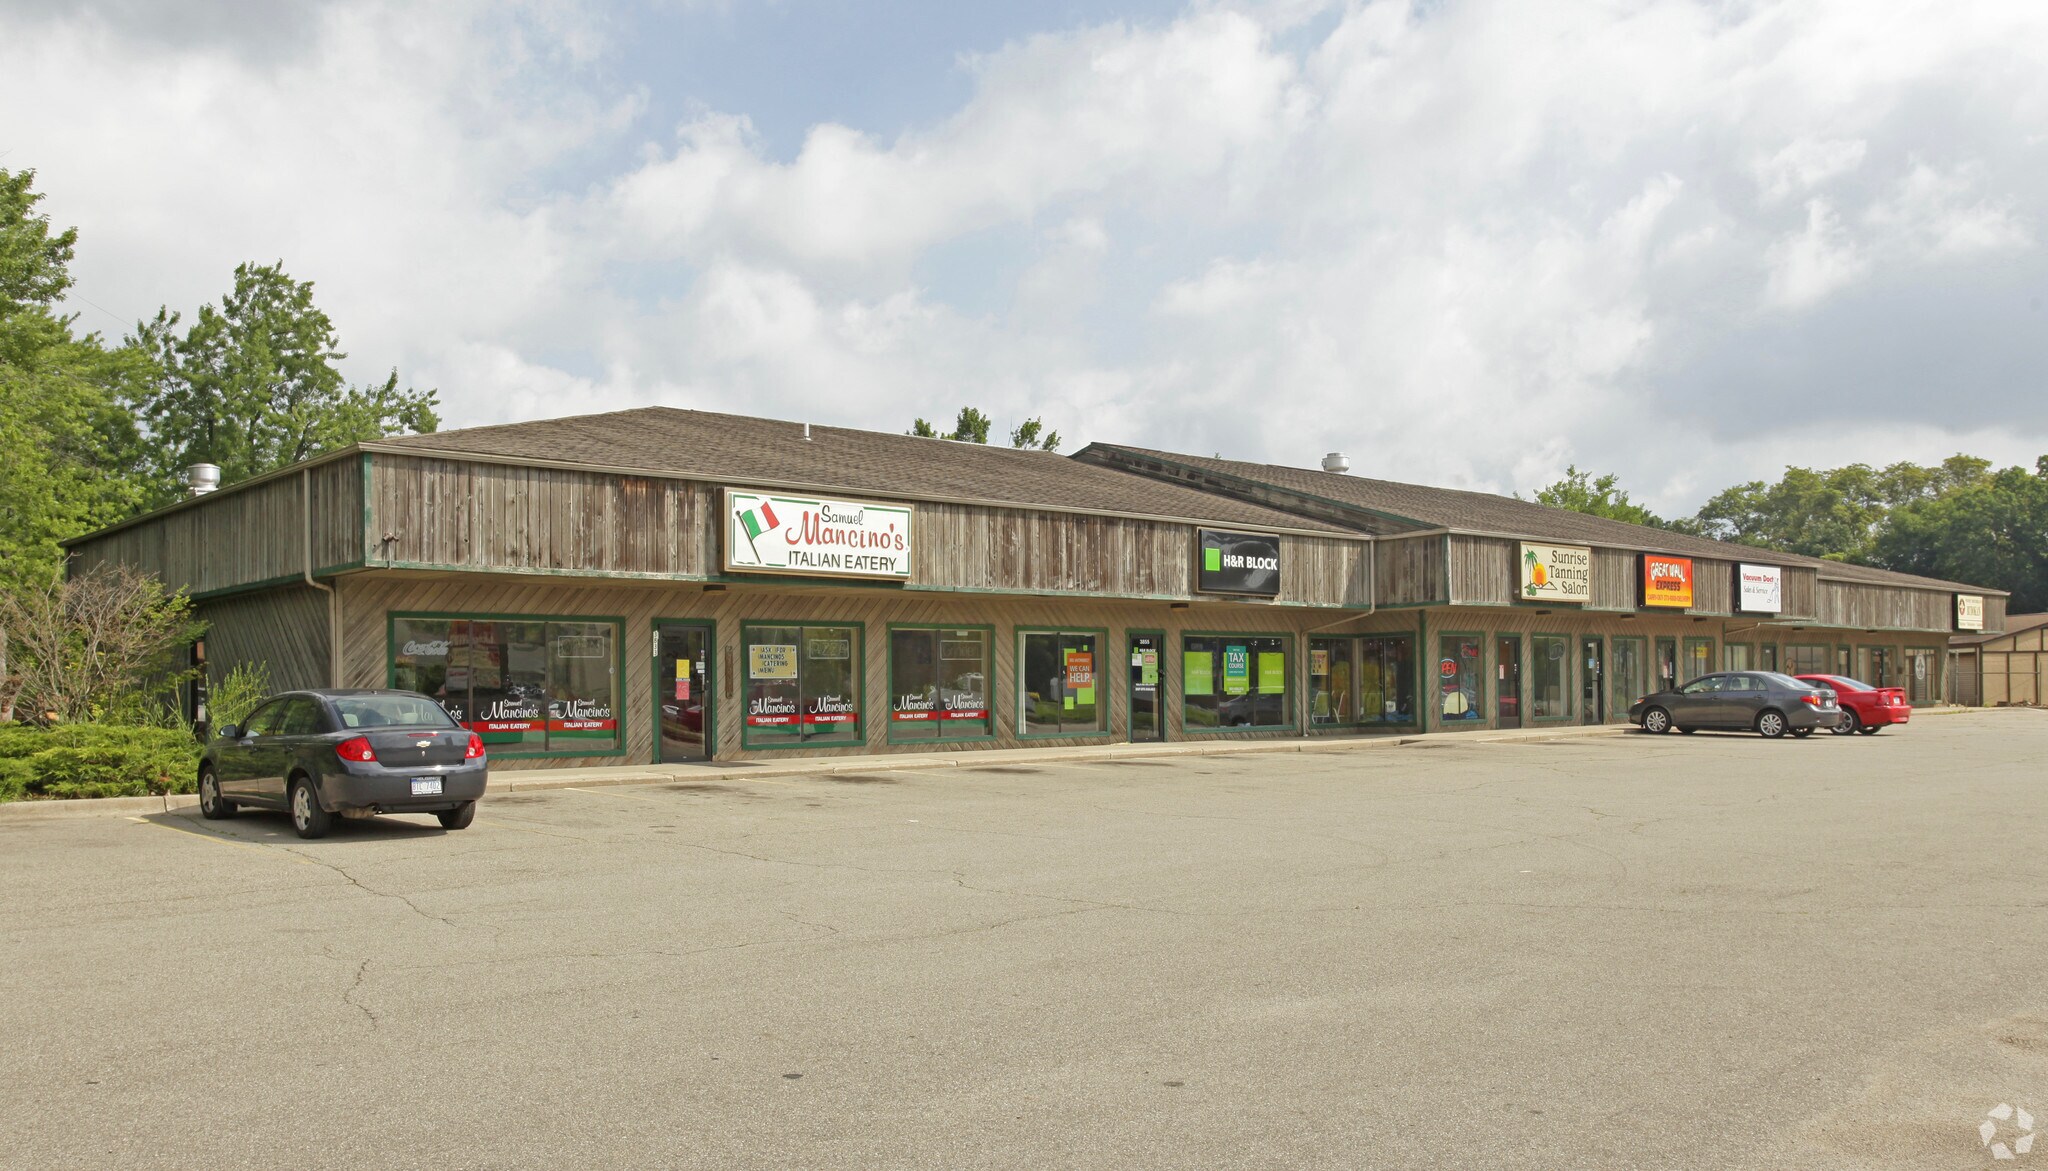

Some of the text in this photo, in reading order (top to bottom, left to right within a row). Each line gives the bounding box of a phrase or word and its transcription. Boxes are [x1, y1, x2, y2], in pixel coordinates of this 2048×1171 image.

[821, 504, 864, 526] Samuel
[785, 510, 904, 551] Mancino's
[788, 550, 897, 571] ITALIAN EATERY
[1223, 554, 1278, 571] H&R BLOCK
[1551, 550, 1587, 566] Sunrise
[1549, 565, 1588, 584] Tanning
[1650, 562, 1686, 582] GREAT WALL
[1742, 573, 1762, 581] Vacuum
[1561, 581, 1588, 595] Salon
[1656, 580, 1681, 591] EXPRESS
[1228, 653, 1244, 662] TAX
[1069, 672, 1090, 683] HELP.
[480, 701, 539, 720] Mancino's
[556, 700, 610, 719] Mancino's
[749, 697, 796, 715] Mancino's
[809, 696, 853, 714] Mancino's
[893, 695, 934, 712] Mancino's
[945, 694, 984, 710] Mancino's
